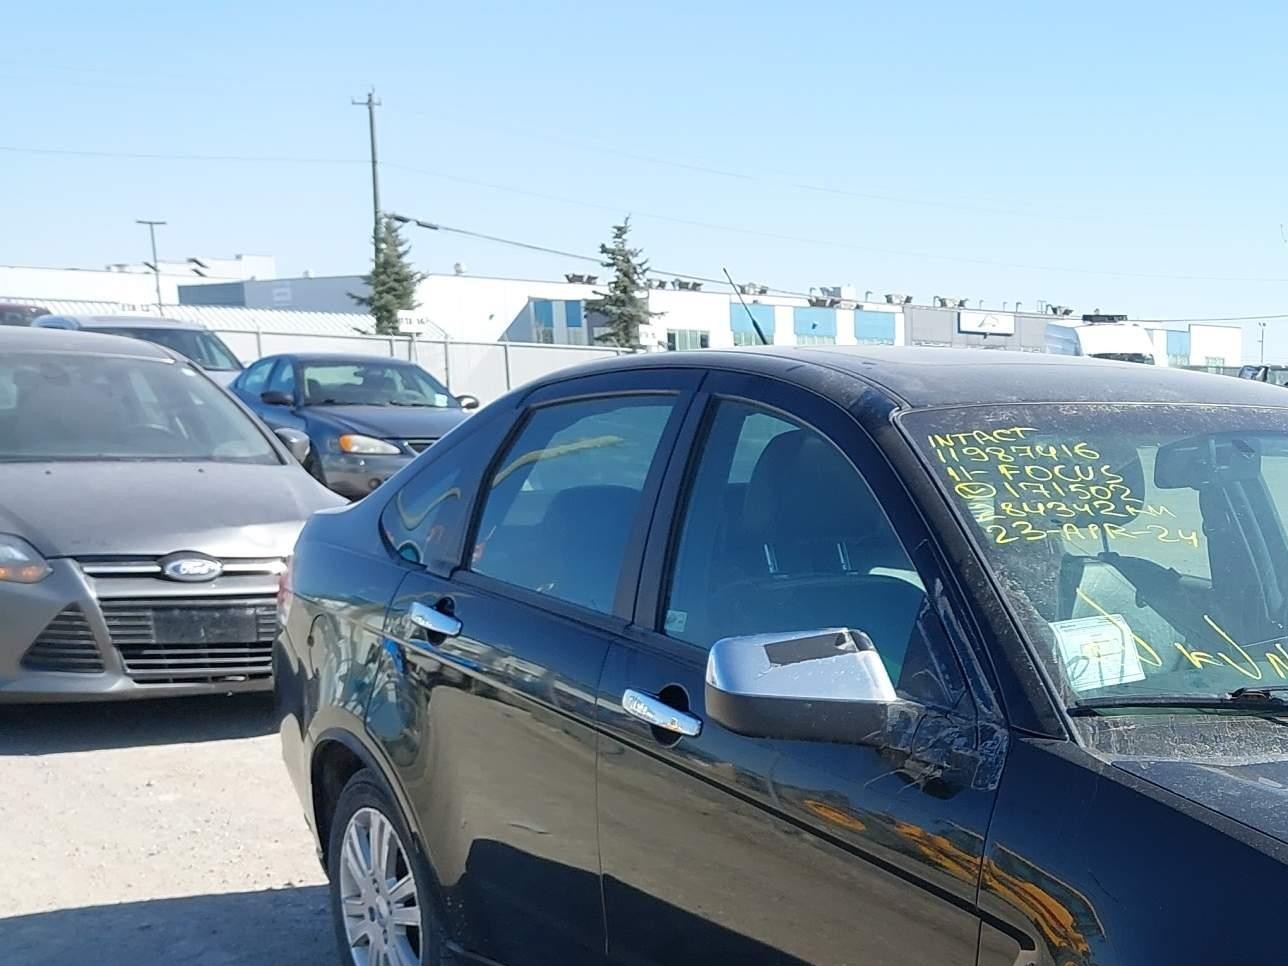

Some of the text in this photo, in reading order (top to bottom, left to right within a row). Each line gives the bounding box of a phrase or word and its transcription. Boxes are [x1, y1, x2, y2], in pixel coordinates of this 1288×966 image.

[928, 426, 1038, 448] INTACT
[937, 442, 1100, 464] 11987416
[998, 464, 1123, 484] FOCUS
[987, 521, 1199, 548] 23-APR-24
